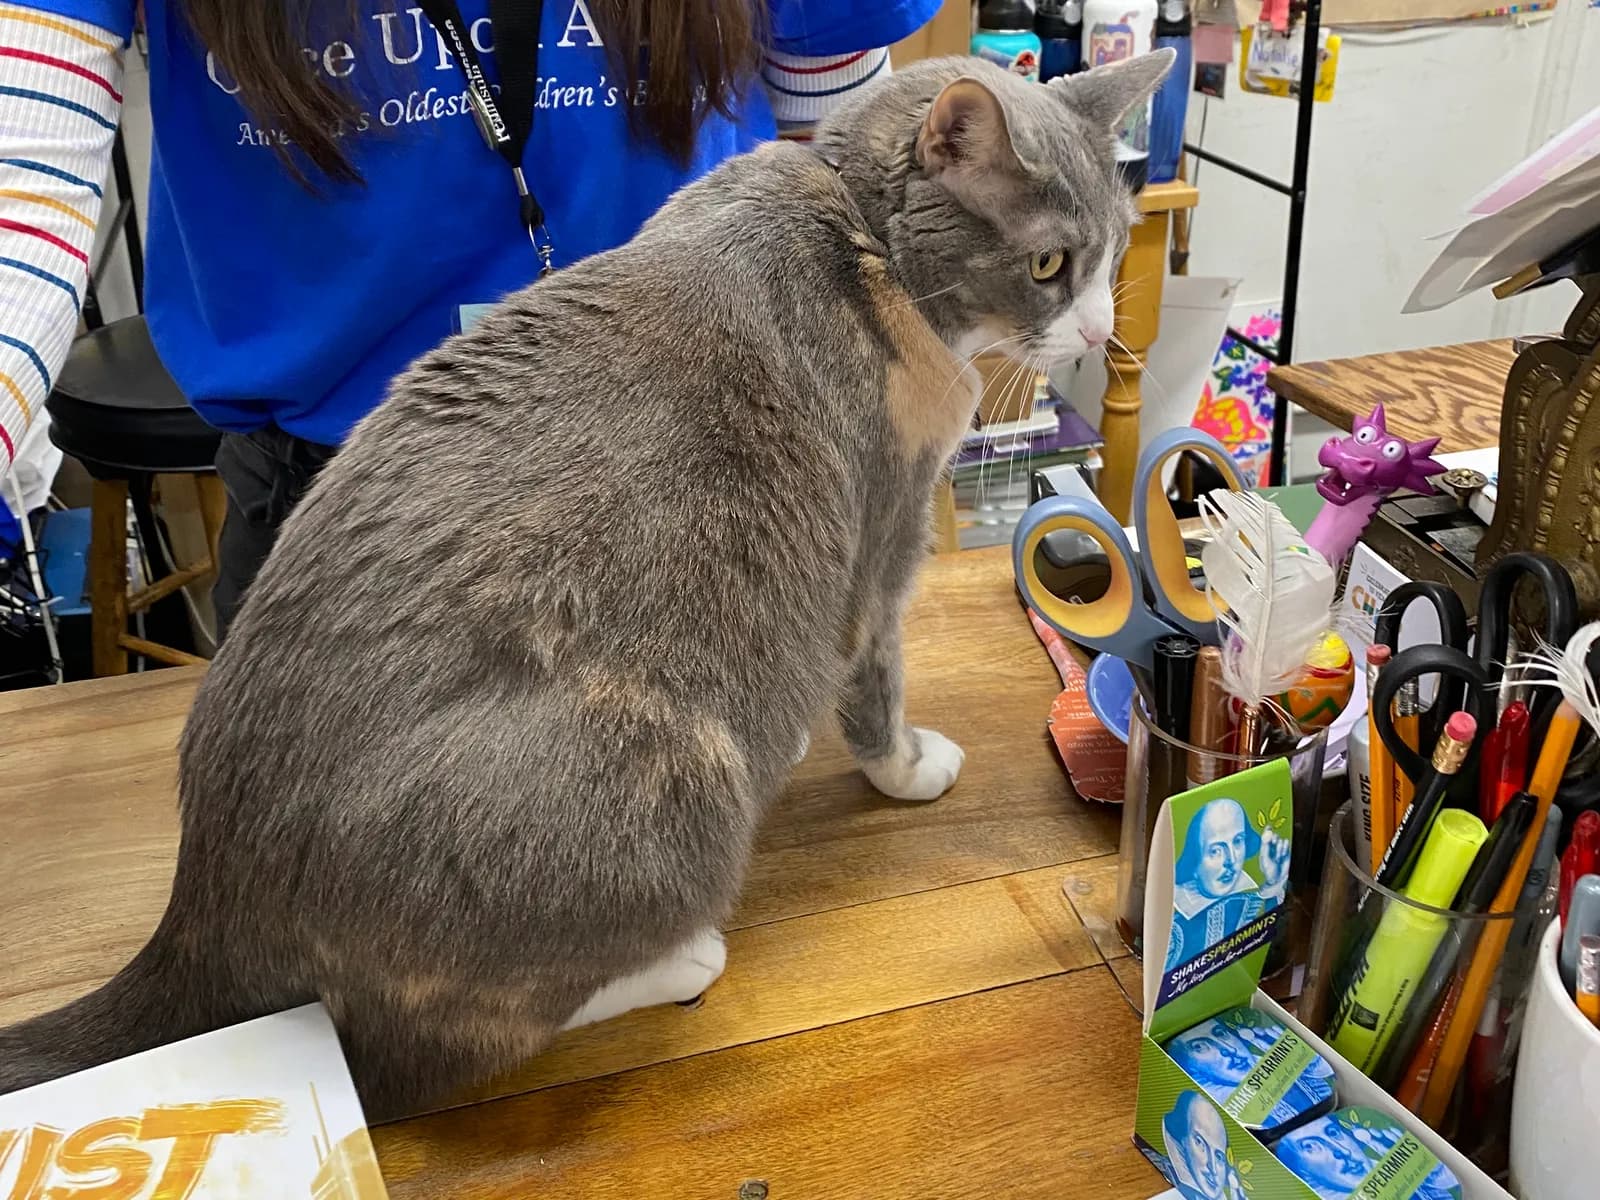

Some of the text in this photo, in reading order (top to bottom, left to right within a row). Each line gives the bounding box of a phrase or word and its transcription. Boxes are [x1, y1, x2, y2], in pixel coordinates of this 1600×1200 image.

[556, 0, 604, 47] A
[379, 87, 475, 127] Oldest
[470, 64, 511, 142] Peninsula
[1170, 912, 1277, 985] SHAKESPEARMINTS
[1225, 1034, 1299, 1117] SHAKESPEARMINTS
